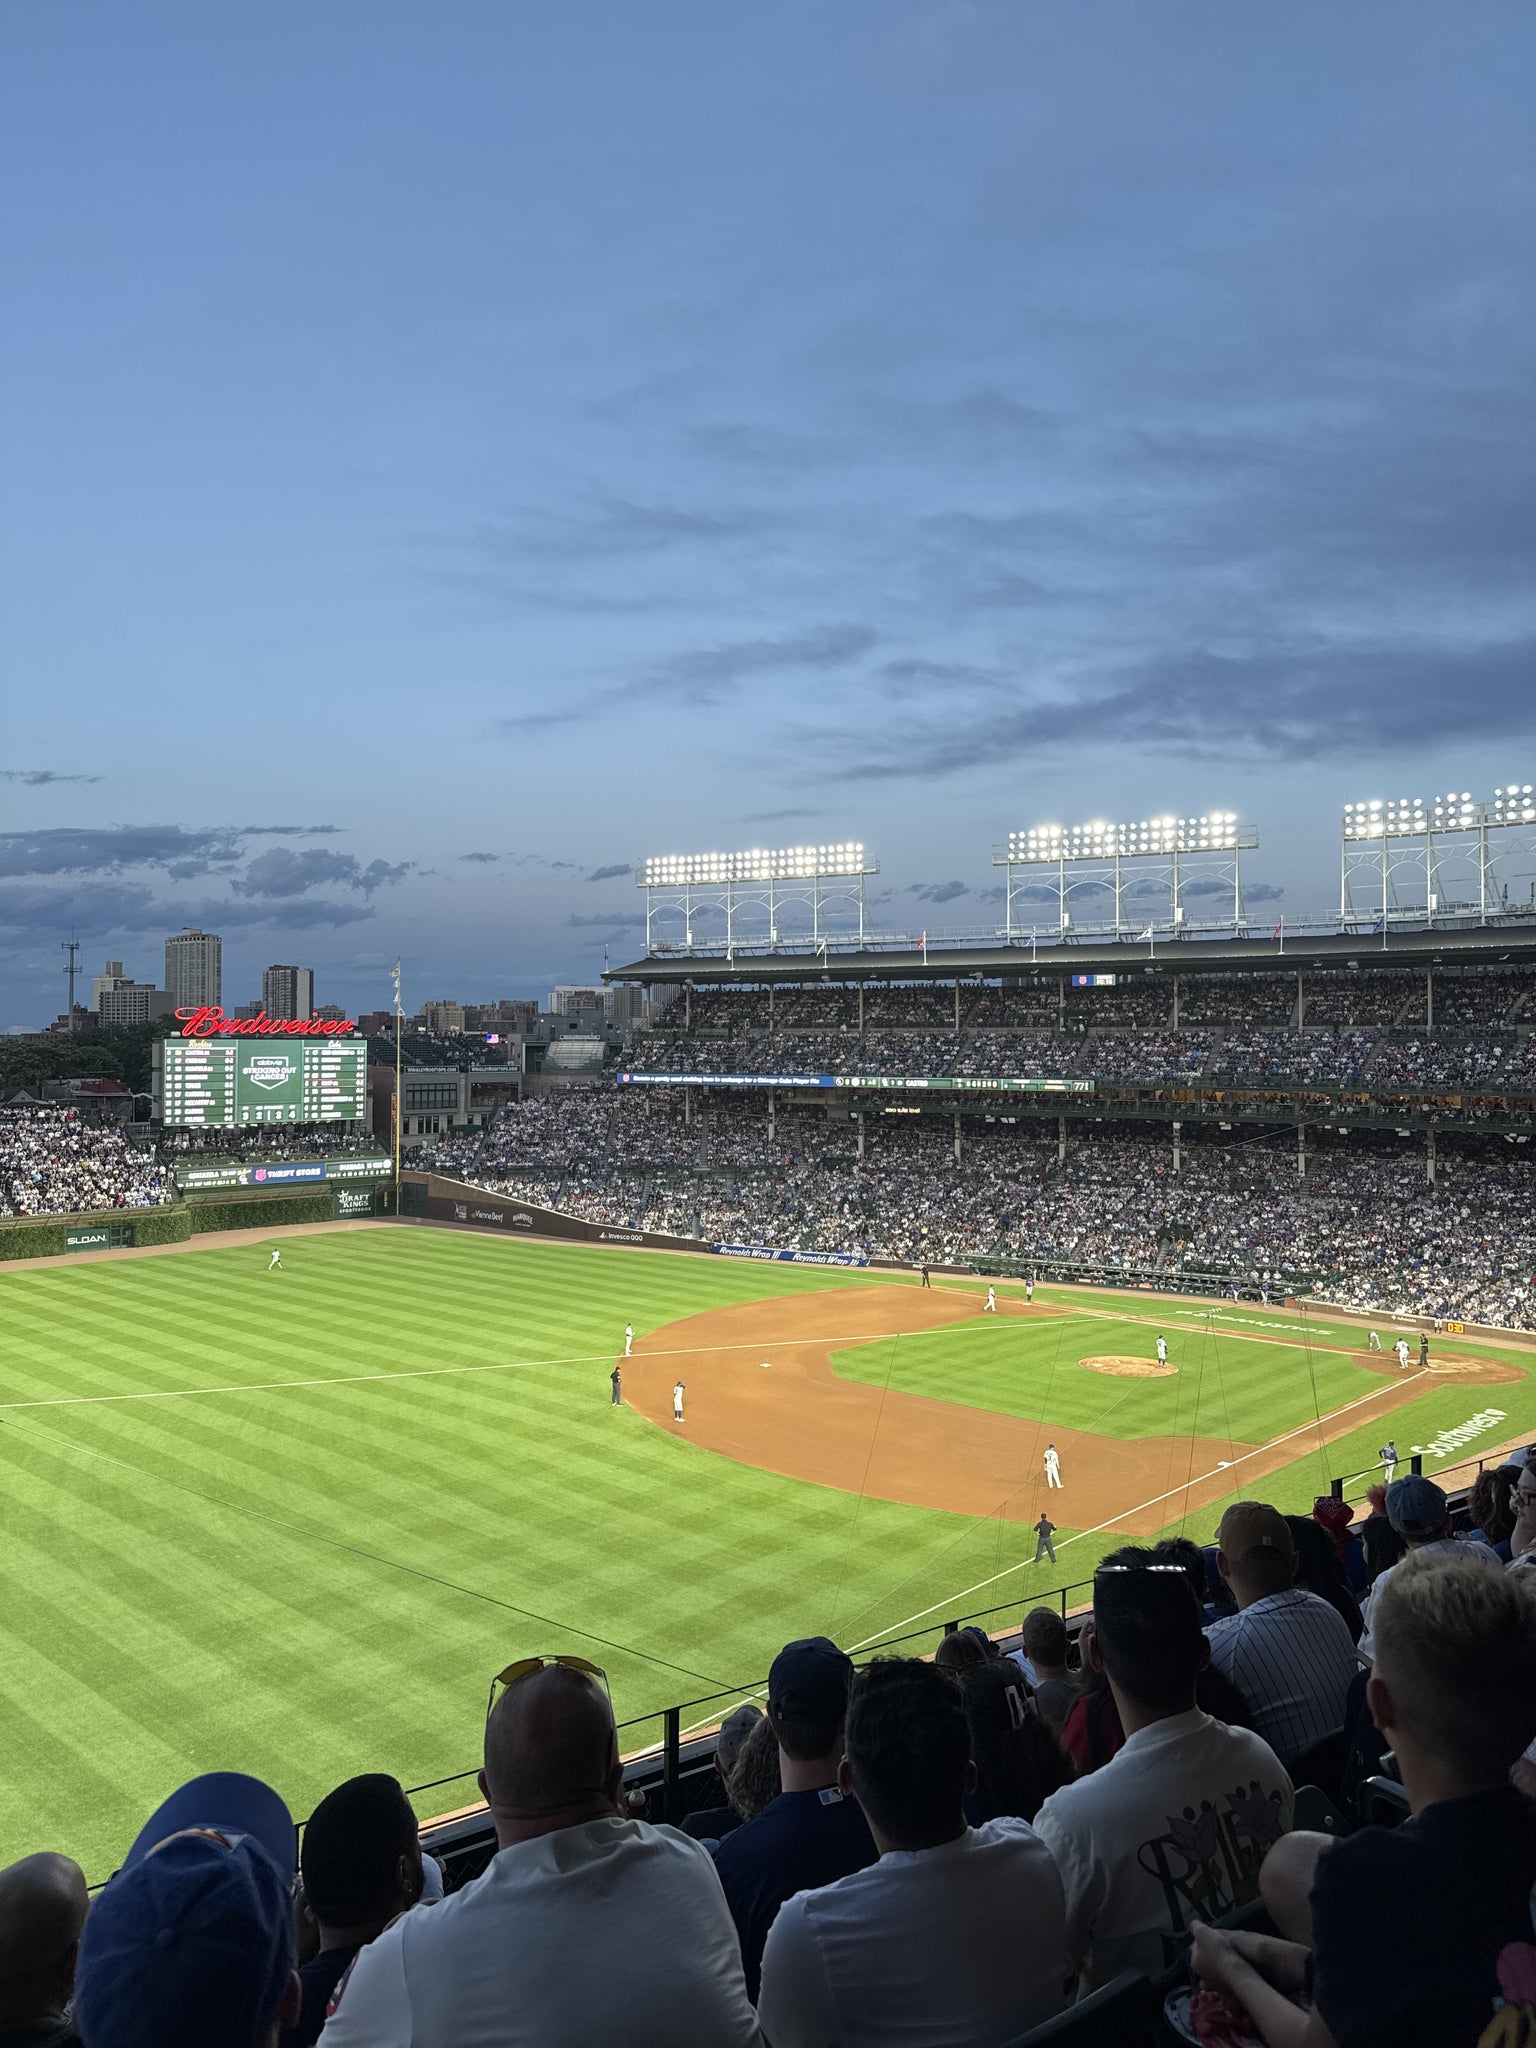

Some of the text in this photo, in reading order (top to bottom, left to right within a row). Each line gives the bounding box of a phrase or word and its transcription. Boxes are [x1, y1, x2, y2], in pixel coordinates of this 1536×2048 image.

[174, 1006, 355, 1037] Budweiser
[281, 1066, 297, 1074] OUT
[255, 1111, 263, 1120] 2
[275, 1110, 283, 1119] 2
[267, 1169, 294, 1178] THRIFT
[296, 1168, 320, 1176] STORE
[339, 1194, 370, 1203] DRAFT
[475, 1210, 491, 1220] Vienna
[491, 1212, 503, 1223] Beef
[512, 1213, 533, 1225] MARQUEE
[67, 1234, 105, 1245] SLOAN
[608, 1232, 643, 1242] Invesco QQQ
[719, 1246, 770, 1259] Reynolds Wrap
[792, 1253, 848, 1266] Reynolds Wrap
[1410, 1413, 1504, 1458] Southwest
